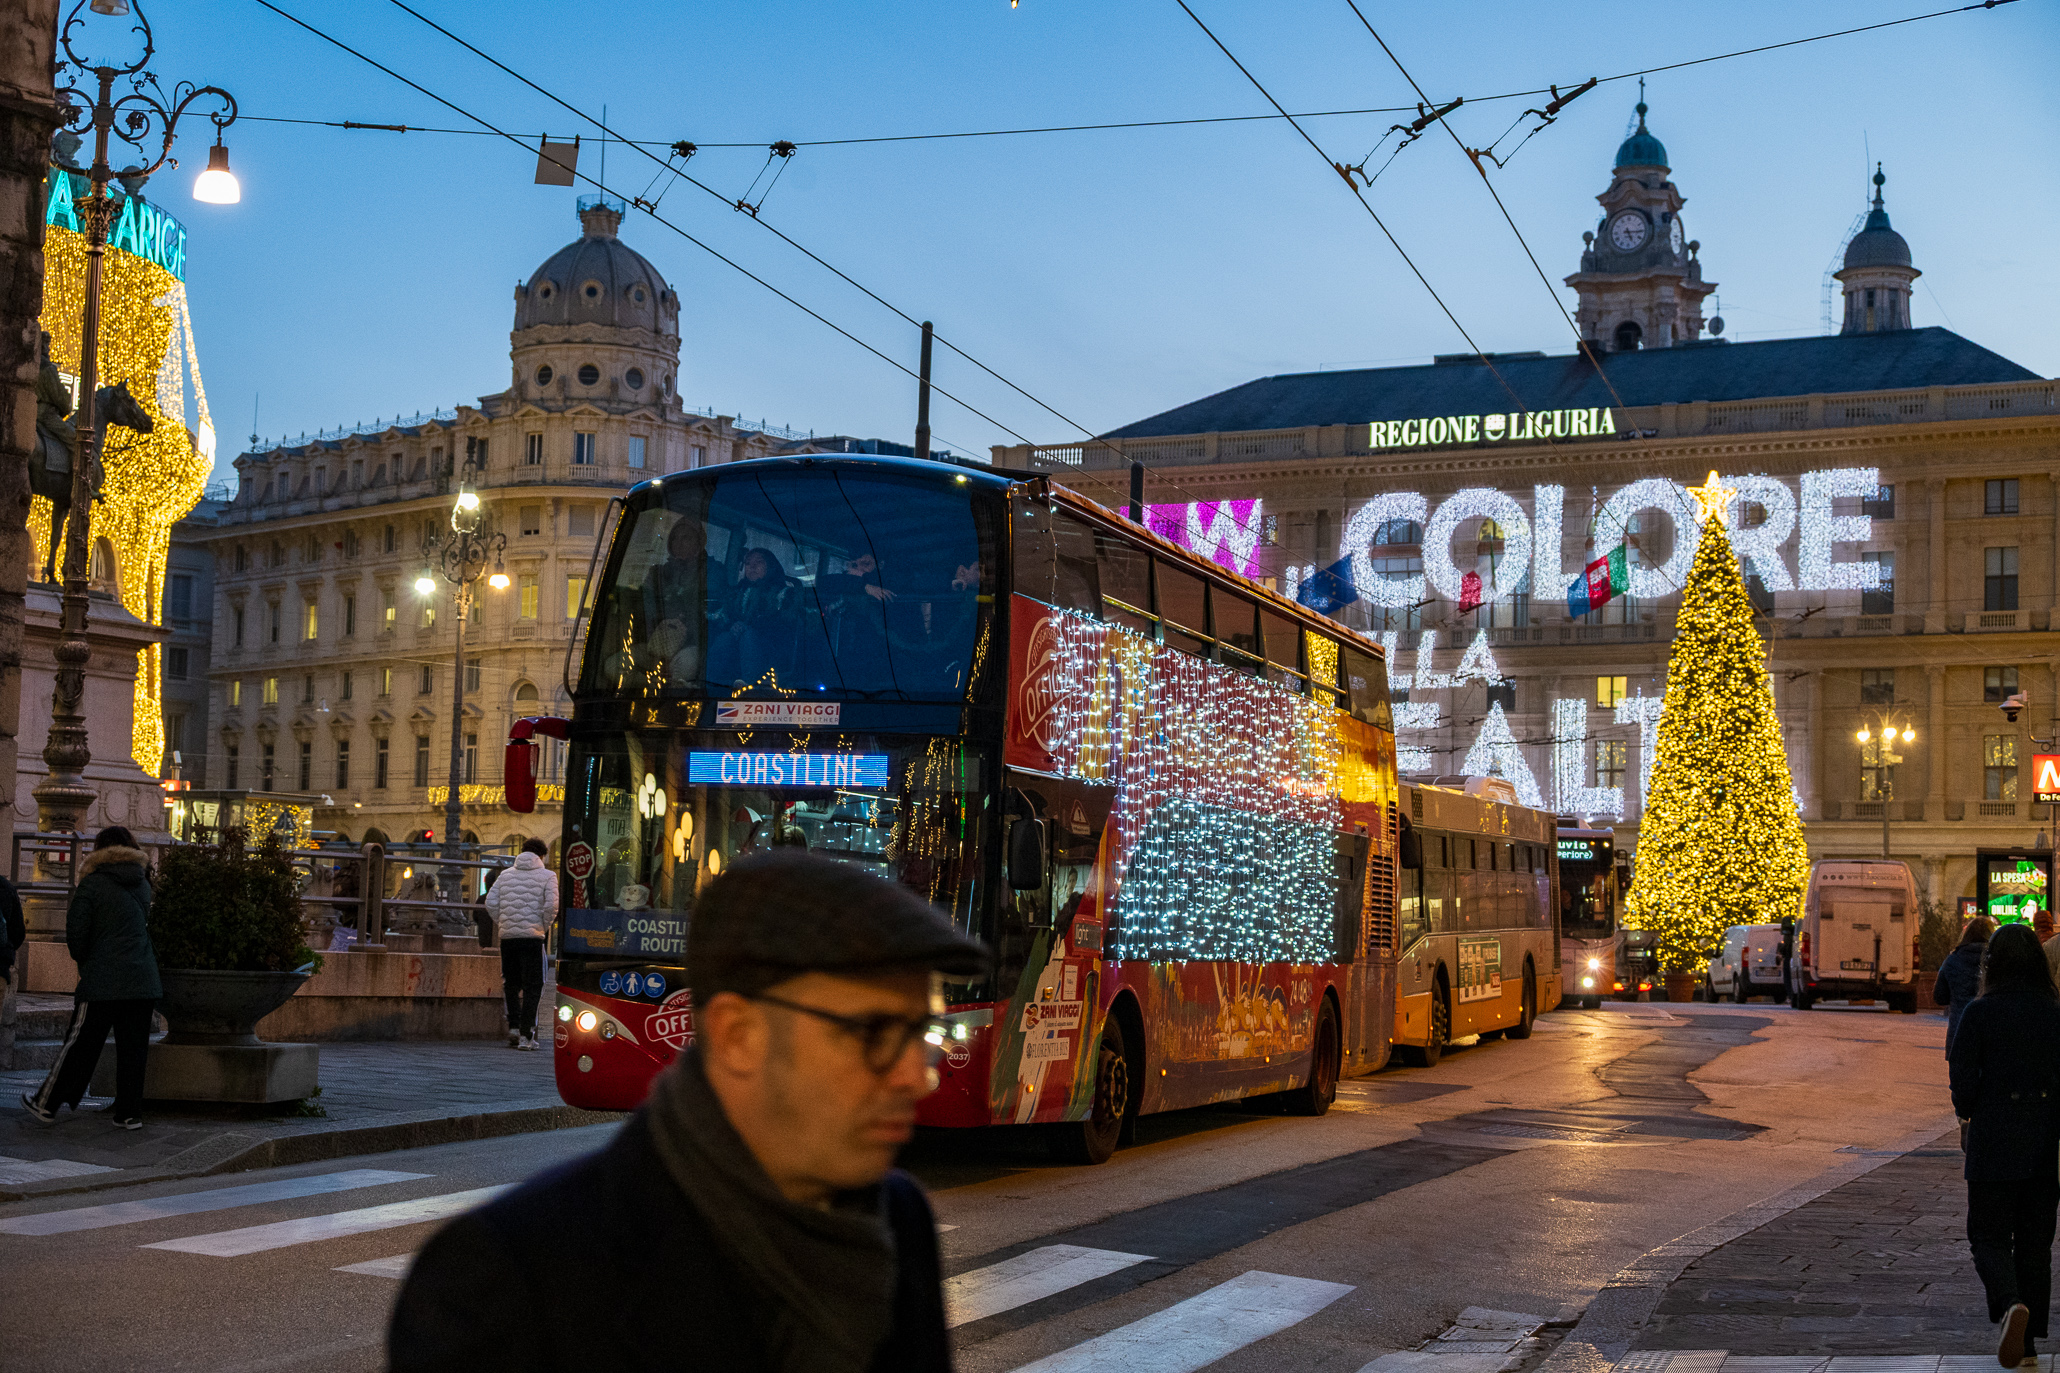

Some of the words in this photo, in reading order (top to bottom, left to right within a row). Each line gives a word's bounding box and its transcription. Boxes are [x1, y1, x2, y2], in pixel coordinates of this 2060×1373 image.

[88, 187, 187, 283] ARIGE
[1368, 414, 1480, 448] REGIONE
[1508, 407, 1616, 440] LIGURIA
[1340, 467, 1880, 608] COLORE
[1371, 627, 1514, 690] LLA
[743, 704, 781, 715] ZANI
[786, 704, 840, 716] VIAGGI
[1391, 698, 1668, 816] EALT
[720, 752, 864, 786] COASTLINE
[2040, 793, 2051, 801] De
[568, 853, 591, 868] STOP
[1991, 872, 2001, 883] LA
[2002, 872, 2027, 883] SPESA
[1991, 904, 2018, 916] ONLINE
[640, 937, 688, 954] ROUTE
[1040, 1005, 1056, 1019] ZANI
[1058, 1004, 1080, 1018] VIAGGI
[948, 1053, 969, 1061] 2037
